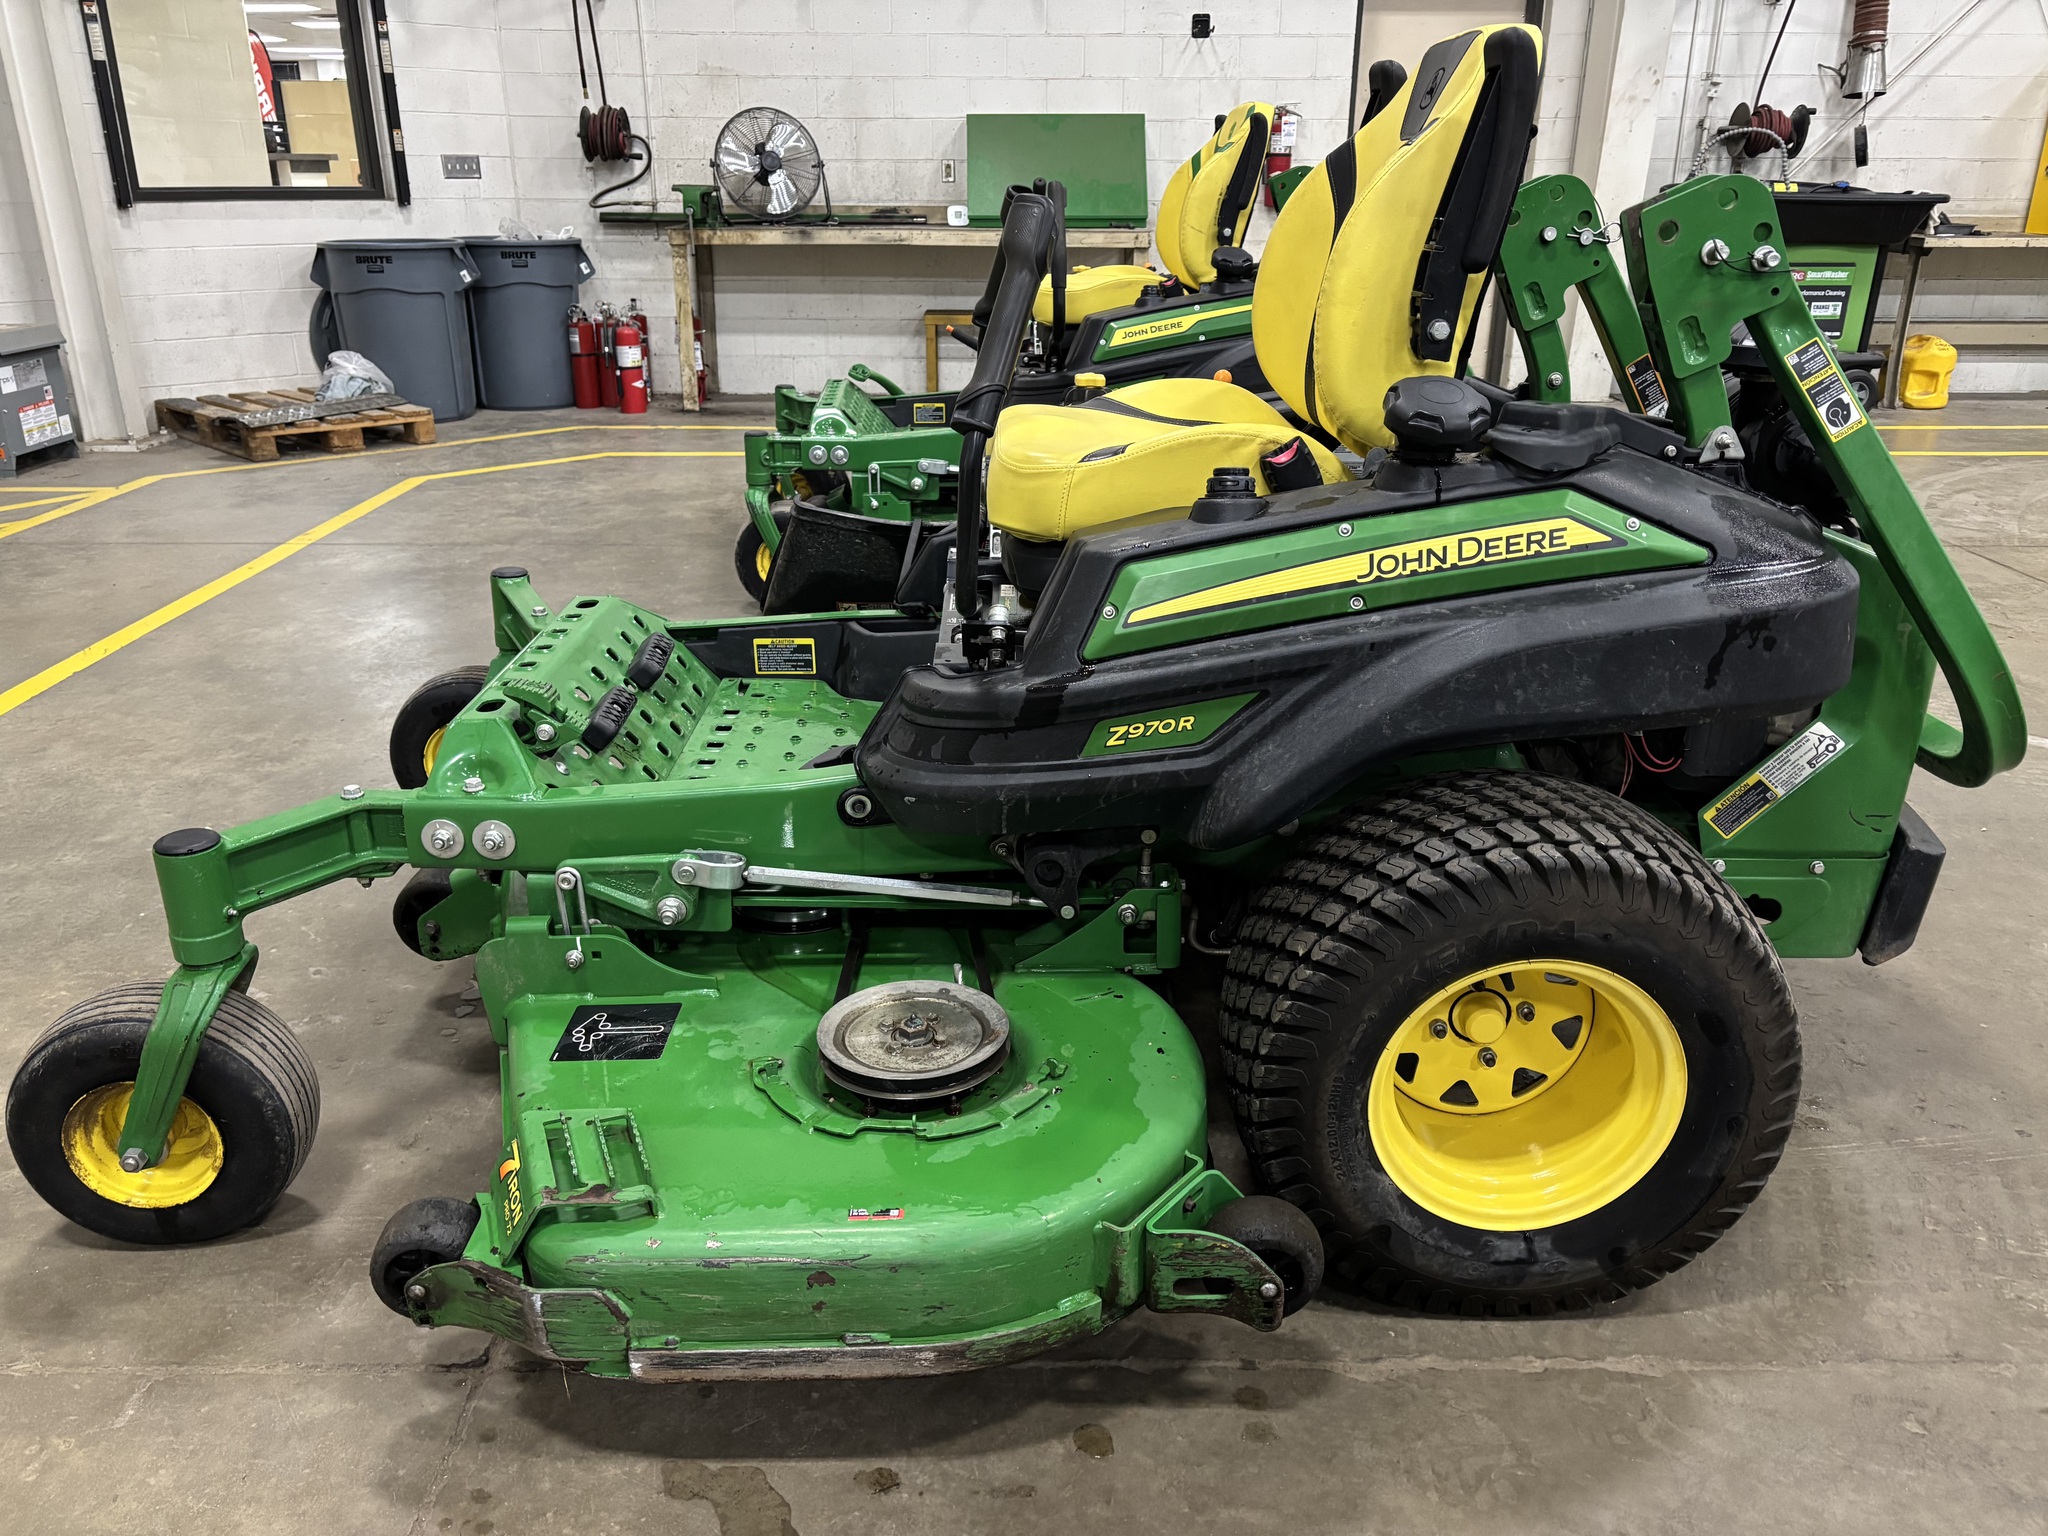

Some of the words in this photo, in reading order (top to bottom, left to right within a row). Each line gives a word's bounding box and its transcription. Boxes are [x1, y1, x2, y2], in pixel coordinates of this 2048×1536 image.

[356, 255, 393, 264] BRUTE
[501, 251, 536, 260] BRUTE
[1356, 545, 1448, 580] JOHN
[1457, 526, 1568, 563] DEERE
[1104, 715, 1196, 747] Z970R
[1719, 782, 1750, 808] ATENCIÓN
